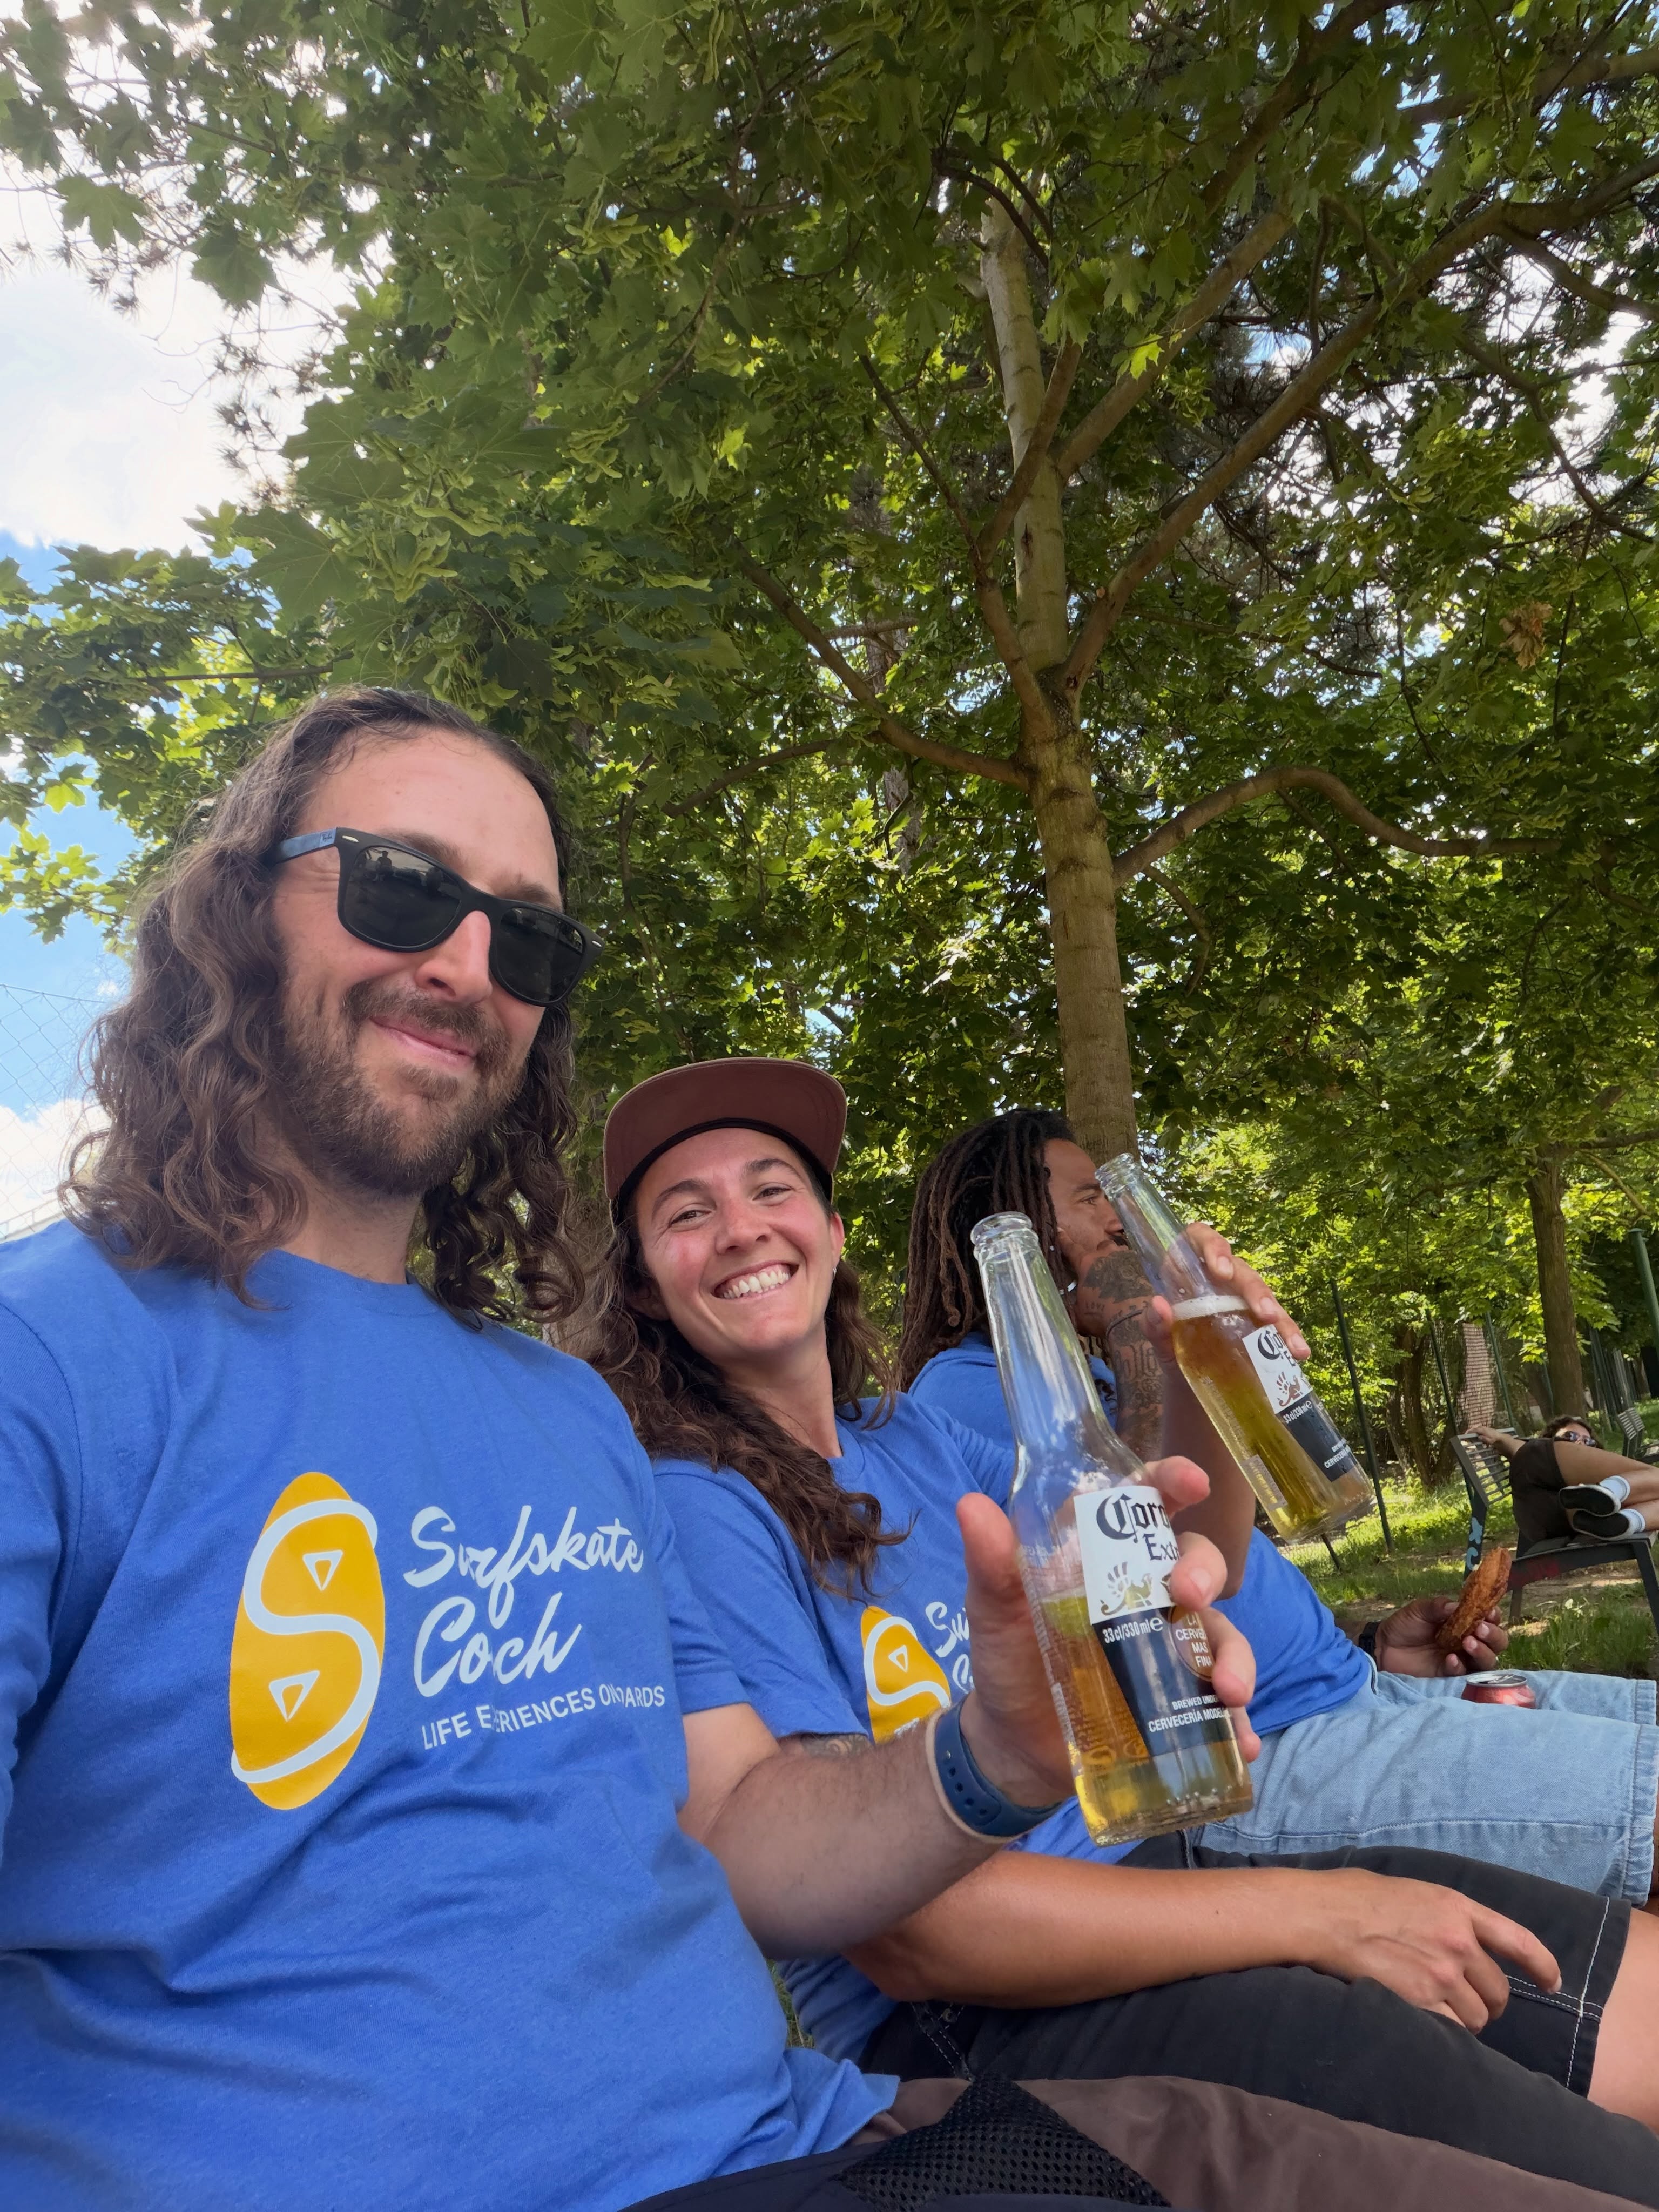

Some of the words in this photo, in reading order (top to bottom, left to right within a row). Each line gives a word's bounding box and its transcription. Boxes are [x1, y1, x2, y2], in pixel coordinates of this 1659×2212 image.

[1096, 1493, 1171, 1543] Coro
[1143, 1533, 1180, 1561] Extr
[403, 1505, 644, 1630] Surfskate
[413, 1591, 582, 1697] Coch
[1175, 1628, 1208, 1641] CERVE
[1172, 1696, 1203, 1710] BREWED
[1202, 1694, 1218, 1704] UNDE
[421, 1712, 473, 1750] LIFE
